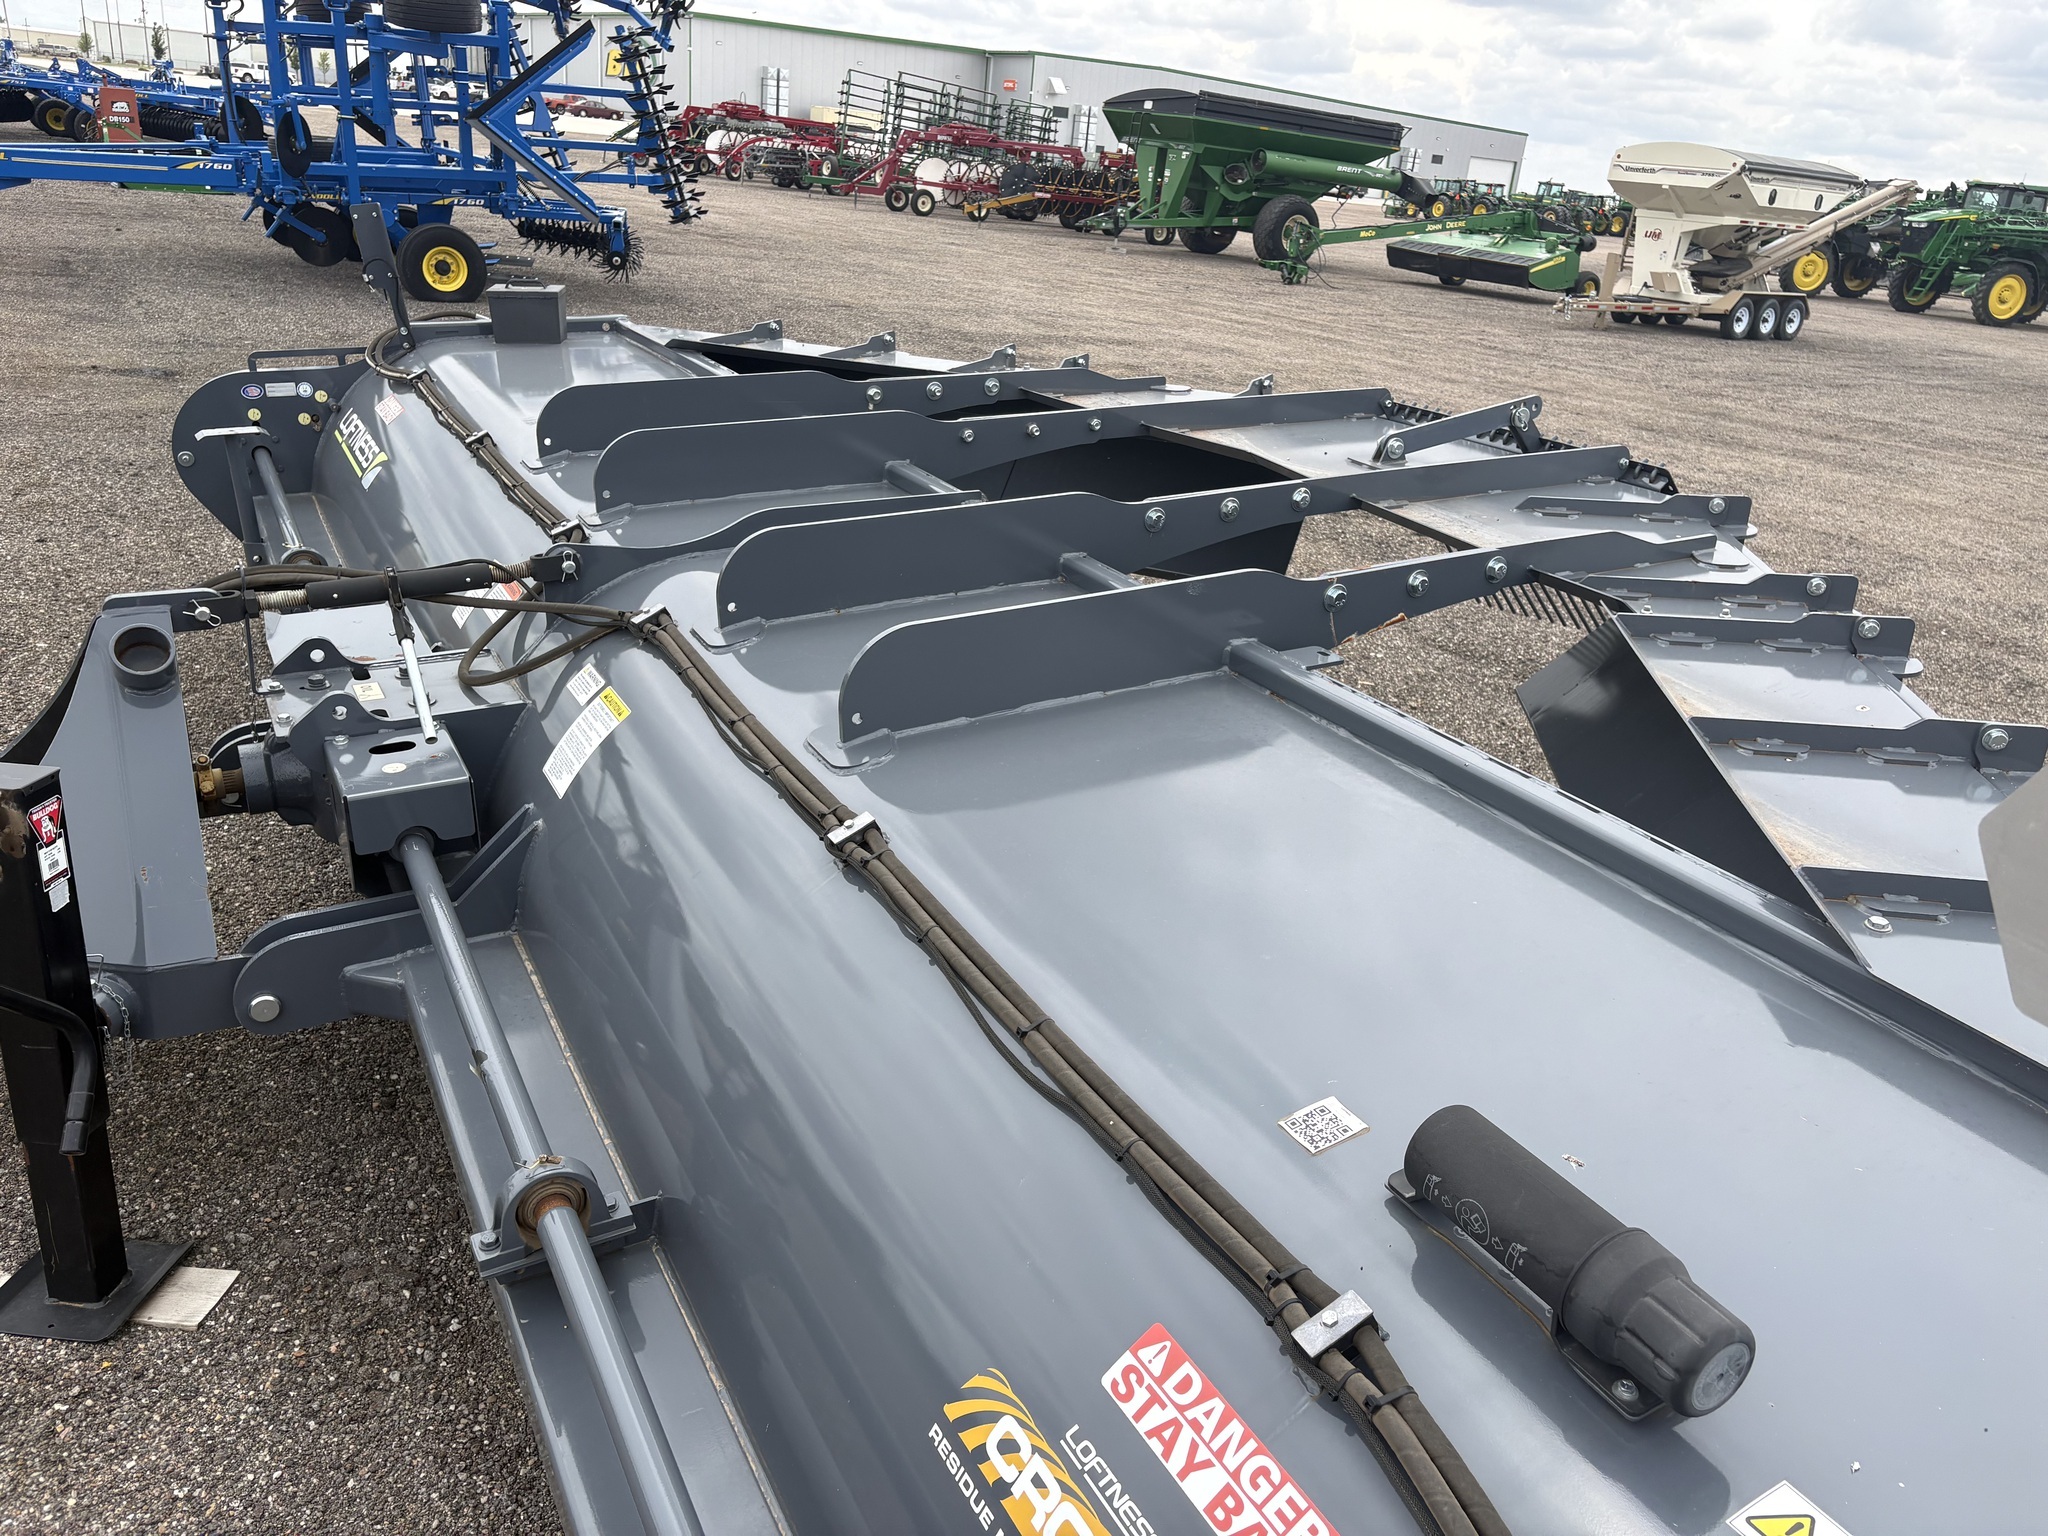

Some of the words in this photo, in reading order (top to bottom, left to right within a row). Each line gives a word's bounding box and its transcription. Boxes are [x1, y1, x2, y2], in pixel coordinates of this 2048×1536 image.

[198, 162, 232, 170] 1760
[1336, 165, 1362, 174] BRENT
[1625, 165, 1657, 174] Unverferth
[453, 198, 485, 206] 1760
[1425, 223, 1442, 231] JOHN
[1446, 221, 1467, 229] DEERE
[339, 407, 381, 469] LOFTNESS
[605, 694, 623, 715] CAUTION
[32, 802, 59, 821] BULLDOG
[1111, 1364, 1216, 1483] STAY
[928, 1422, 995, 1531] RESIDUE
[1065, 1423, 1158, 1536] LOFTNES
